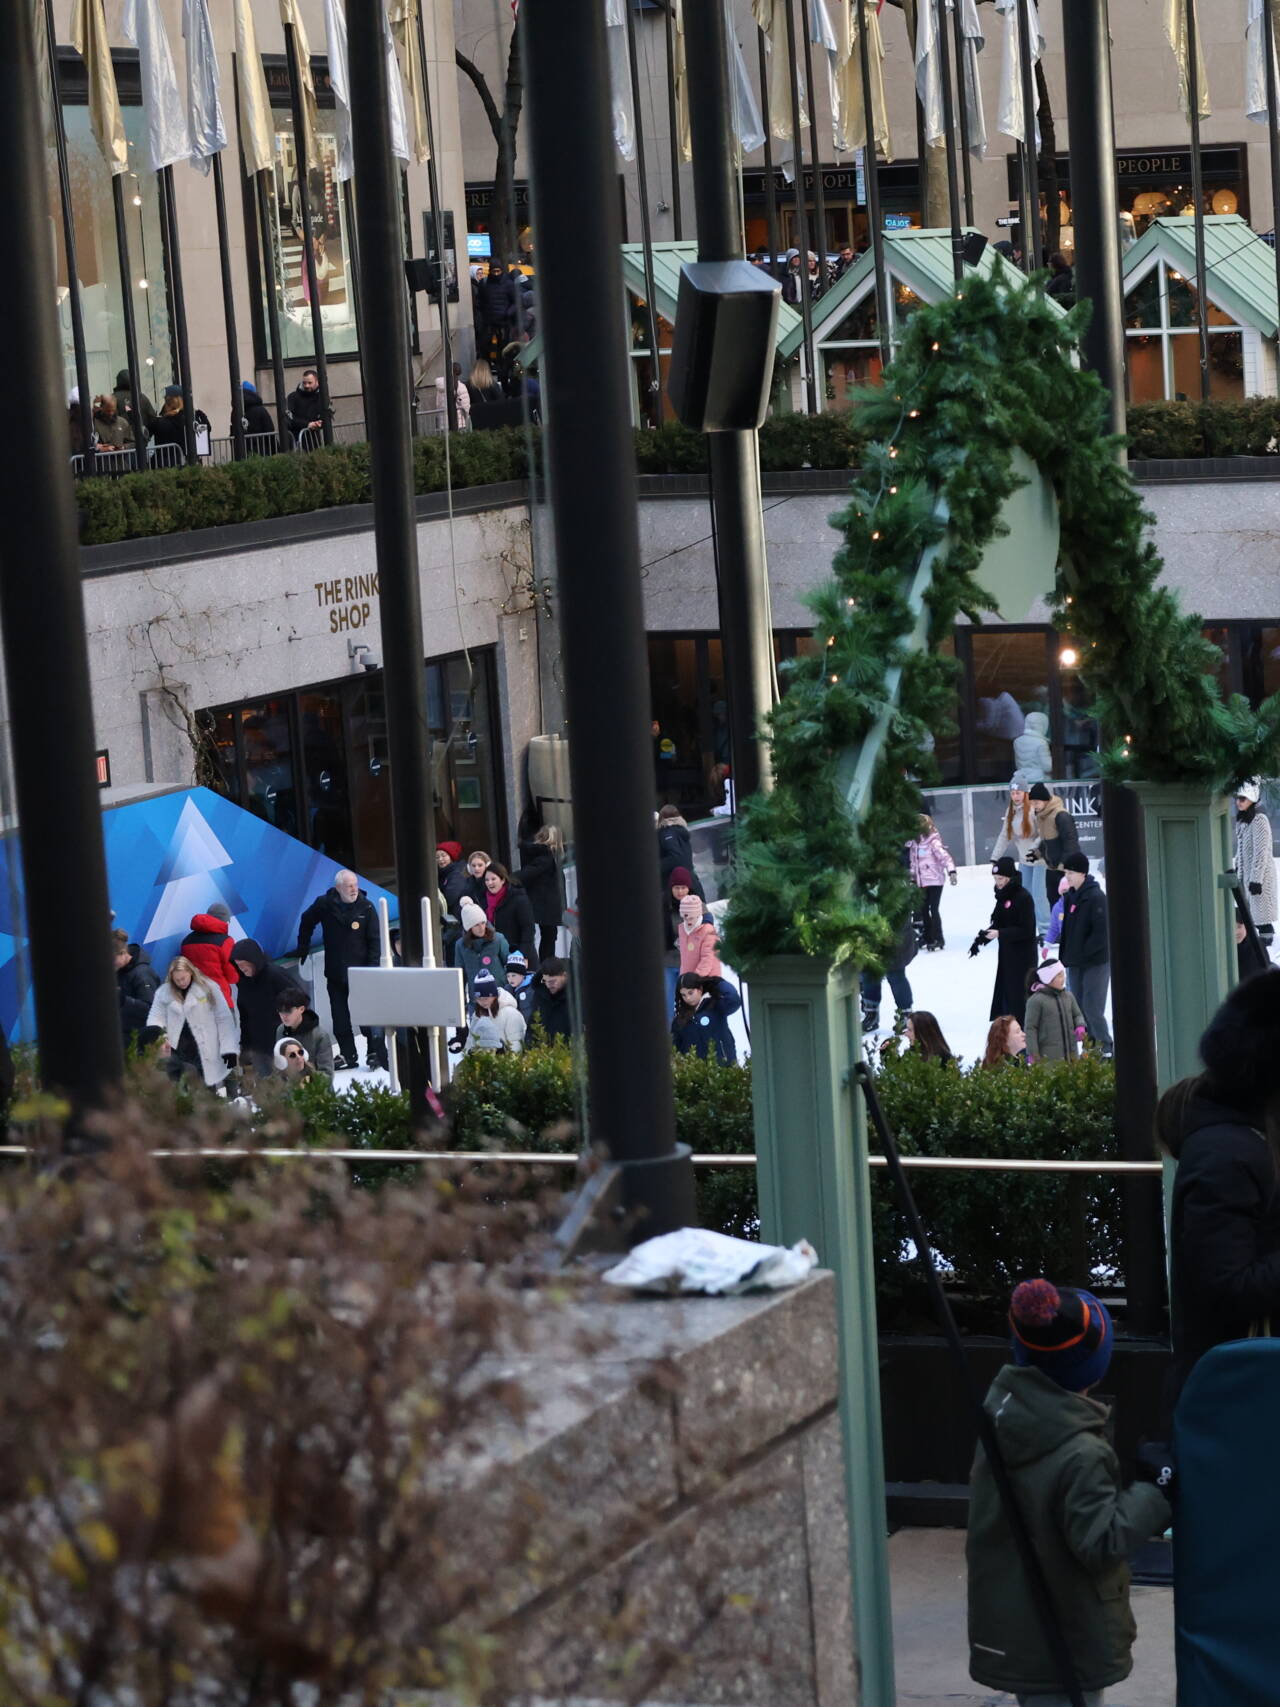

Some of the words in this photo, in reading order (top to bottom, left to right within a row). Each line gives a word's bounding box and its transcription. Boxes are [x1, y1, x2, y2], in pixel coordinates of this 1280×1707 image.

[1118, 157, 1181, 174] PEOPLE
[804, 174, 858, 190] POPL
[314, 579, 342, 607] THE
[344, 571, 383, 602] RINK
[329, 602, 370, 634] SHOP
[1065, 796, 1098, 816] INK
